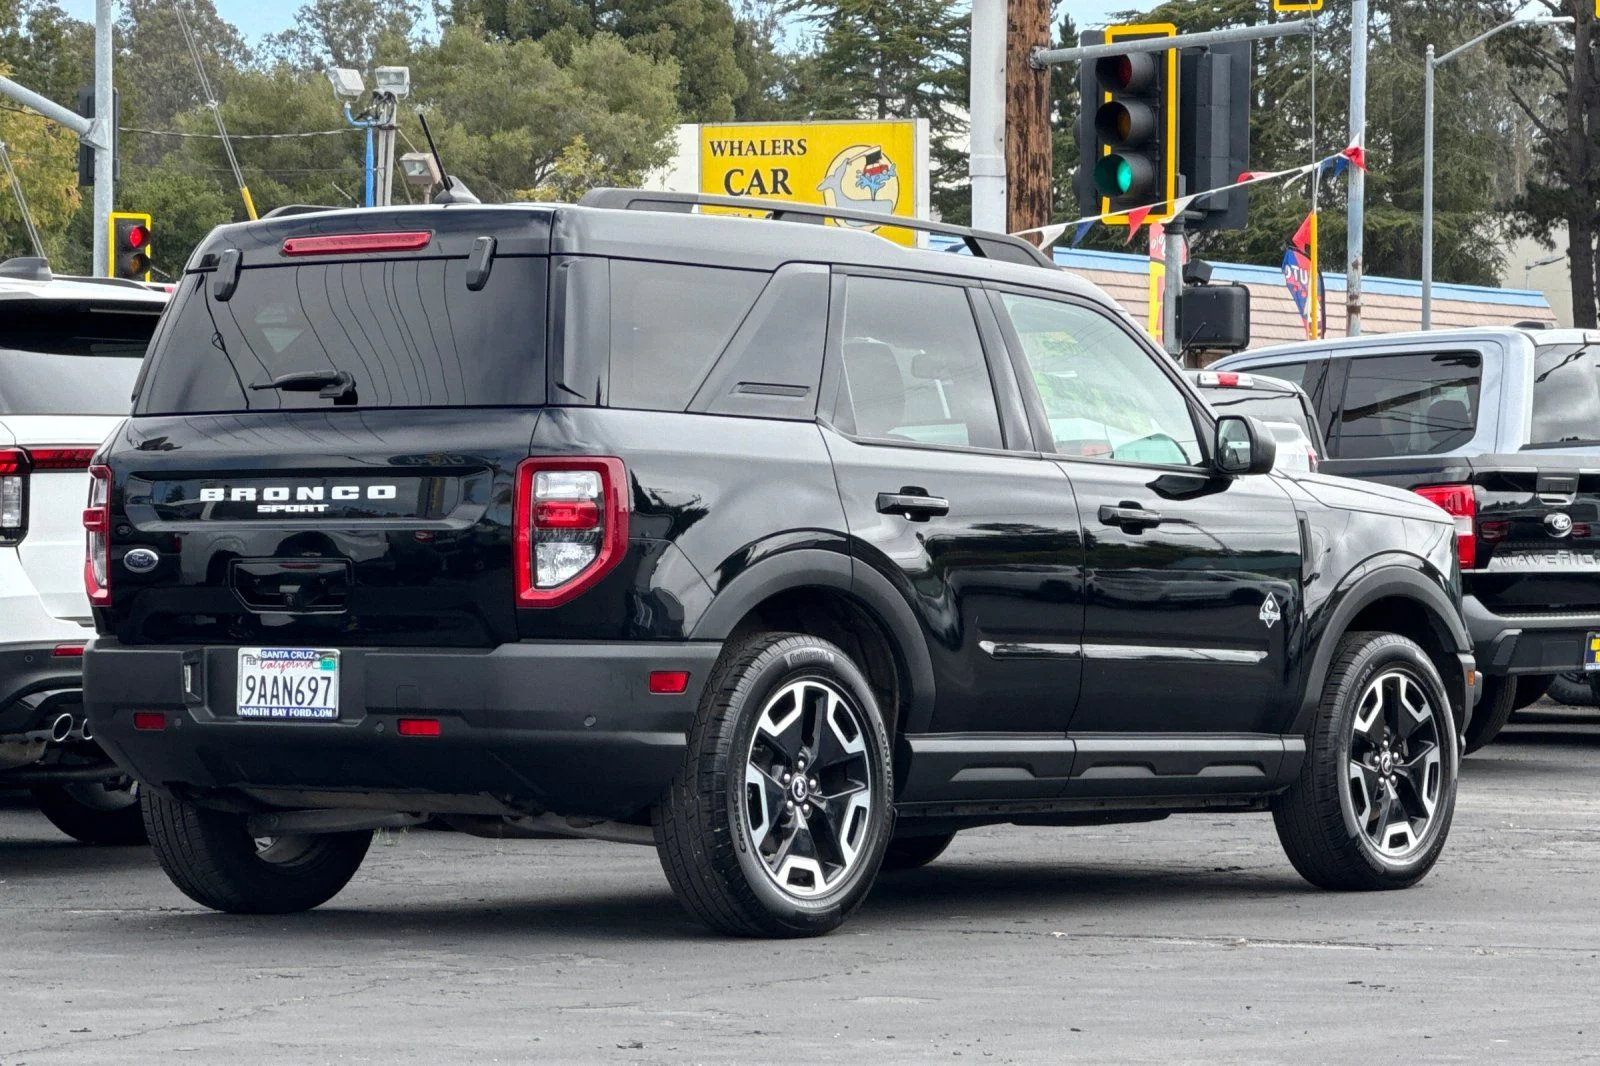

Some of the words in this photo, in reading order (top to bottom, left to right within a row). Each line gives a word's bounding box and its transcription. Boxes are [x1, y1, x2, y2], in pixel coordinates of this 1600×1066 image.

[710, 139, 807, 157] WHALERS
[724, 169, 792, 196] CAR
[199, 485, 397, 502] BRONCO
[257, 504, 329, 513] SPORT
[261, 650, 289, 659] SANTA
[291, 650, 315, 660] CRUZ
[245, 675, 332, 706] 9AAN697
[241, 707, 269, 717] NORTH
[272, 707, 287, 717] BAY
[289, 708, 333, 718] FORD.COM
